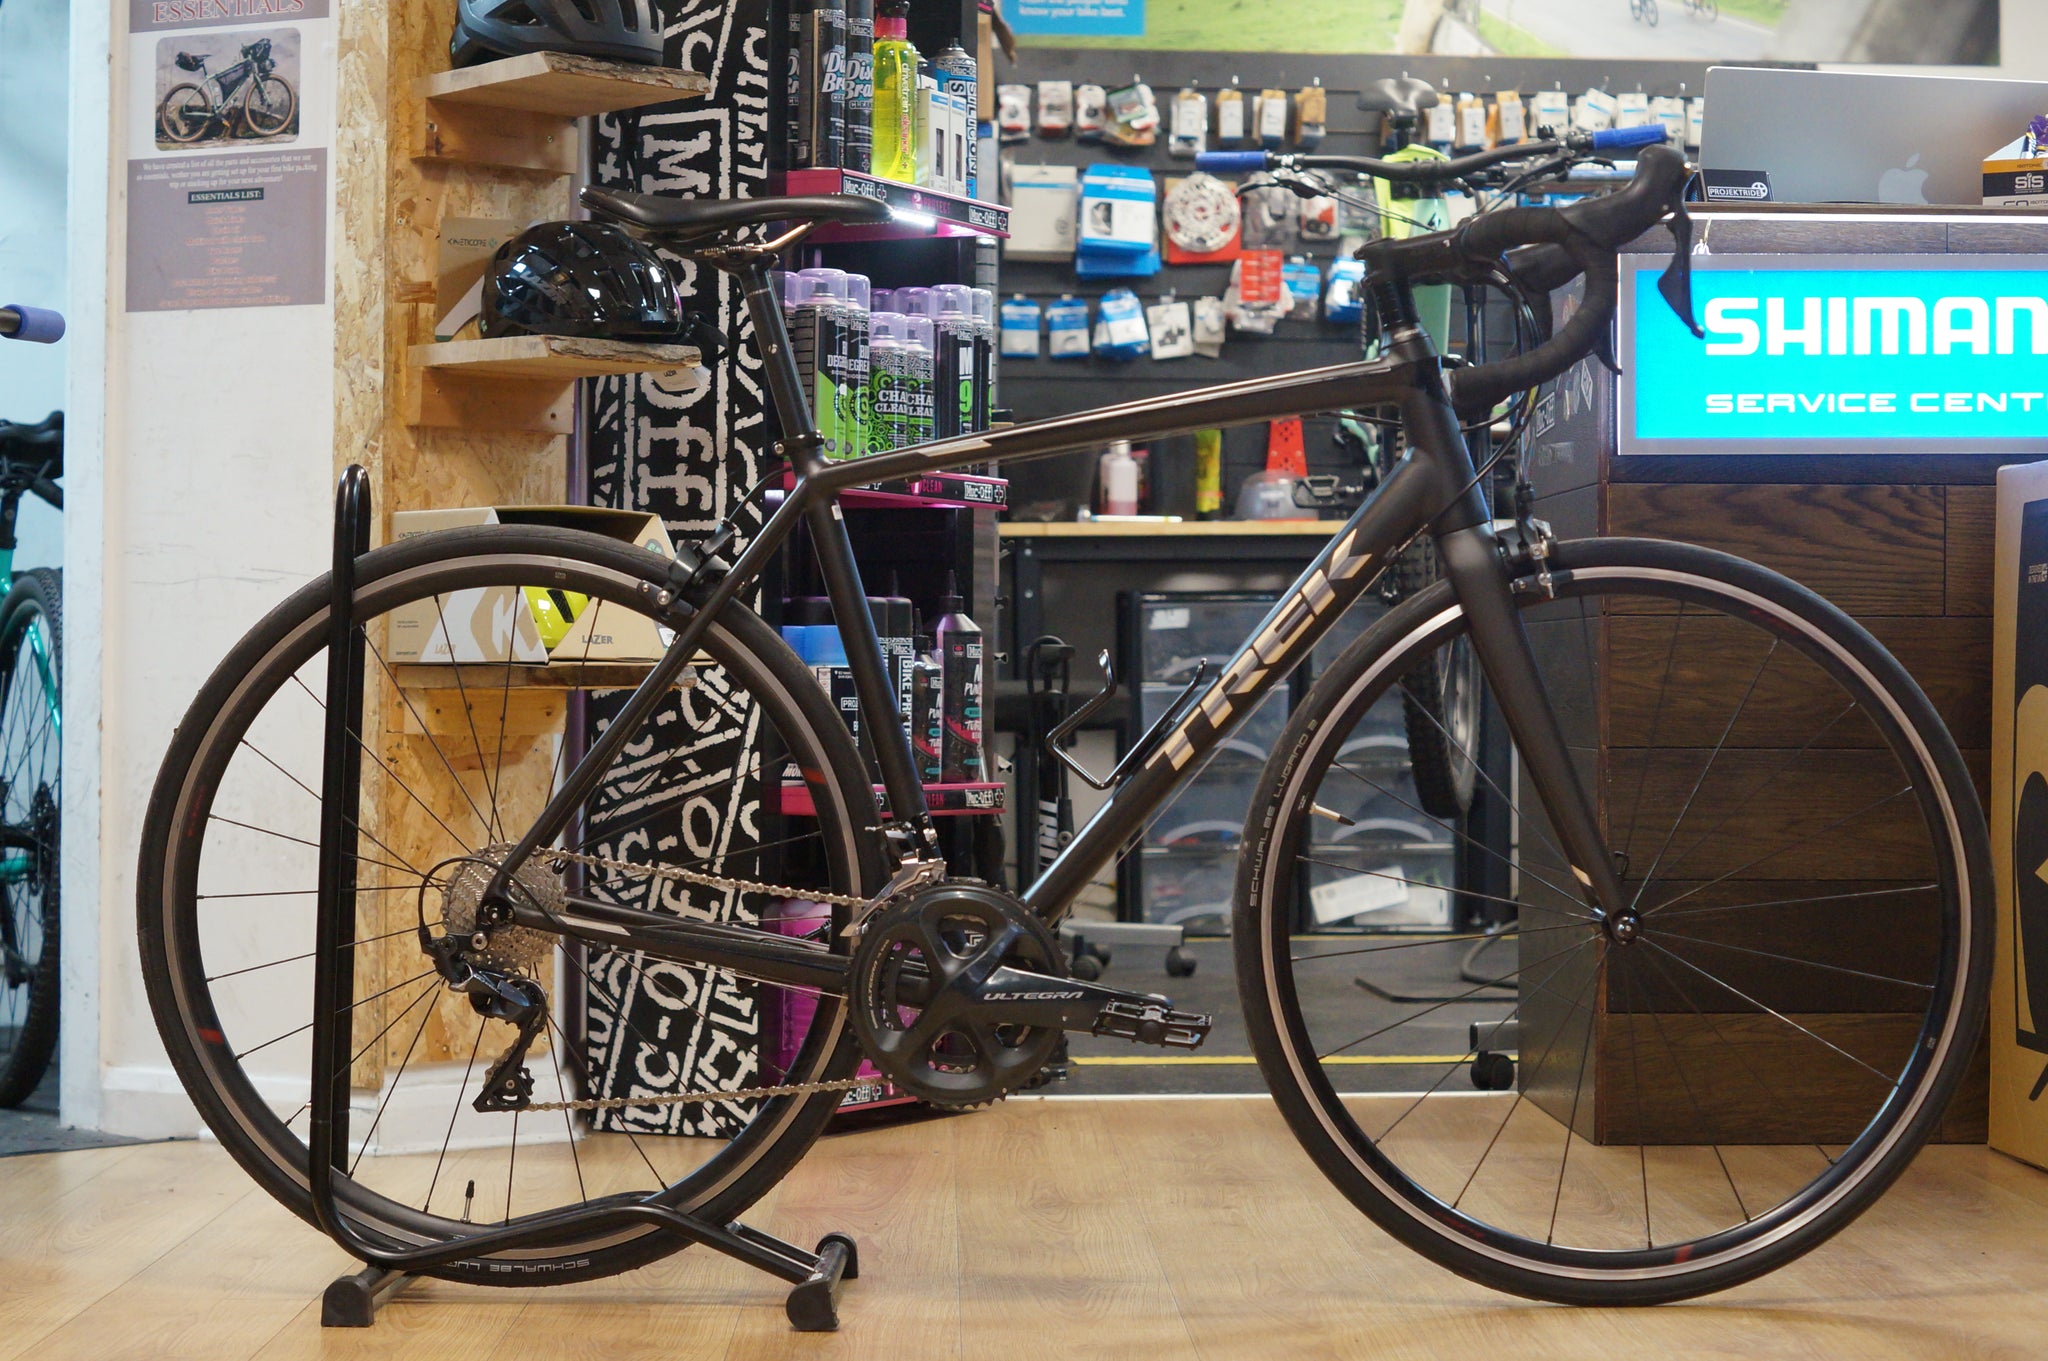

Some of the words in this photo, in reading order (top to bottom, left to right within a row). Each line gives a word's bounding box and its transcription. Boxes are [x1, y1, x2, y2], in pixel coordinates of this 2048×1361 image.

[152, 0, 304, 22] ESSENTIALS
[901, 62, 911, 113] drivetrain
[191, 192, 239, 201] ESSENTIALS
[241, 190, 262, 199] LIST:
[845, 180, 874, 196] Muc-Off
[1709, 188, 1762, 197] PROJEKTRIDE
[970, 207, 996, 227] Muc-Off
[1706, 392, 1897, 413] SERVICE
[966, 484, 992, 499] Muc-Off
[582, 634, 613, 645] LAZER
[1145, 528, 1372, 771] TREK
[902, 659, 913, 691] BIKE
[1250, 804, 1276, 907] SCHWALBE
[1273, 733, 1310, 799] LUGANO
[983, 991, 1084, 1001] ULTEGRA
[489, 1258, 590, 1274] SCHWALBE
